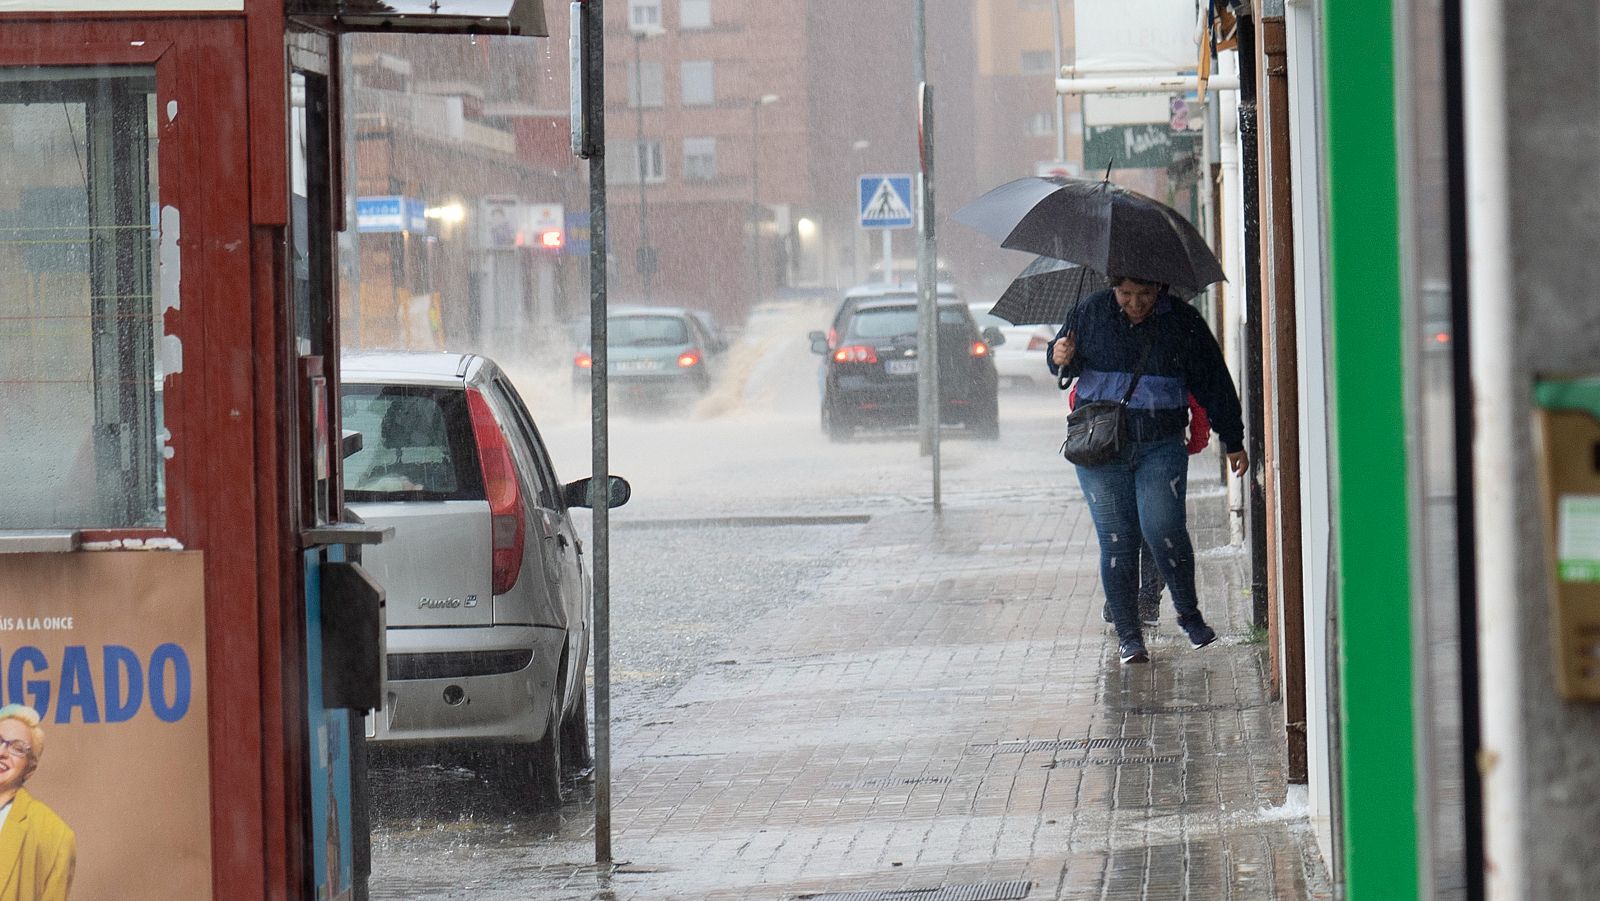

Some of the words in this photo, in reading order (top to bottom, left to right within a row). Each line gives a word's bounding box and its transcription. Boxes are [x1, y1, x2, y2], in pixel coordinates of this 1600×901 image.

[418, 597, 461, 609] Punto
[16, 617, 25, 630] A
[27, 617, 41, 630] LA
[43, 616, 74, 630] ONCE
[0, 642, 192, 724] GADO
